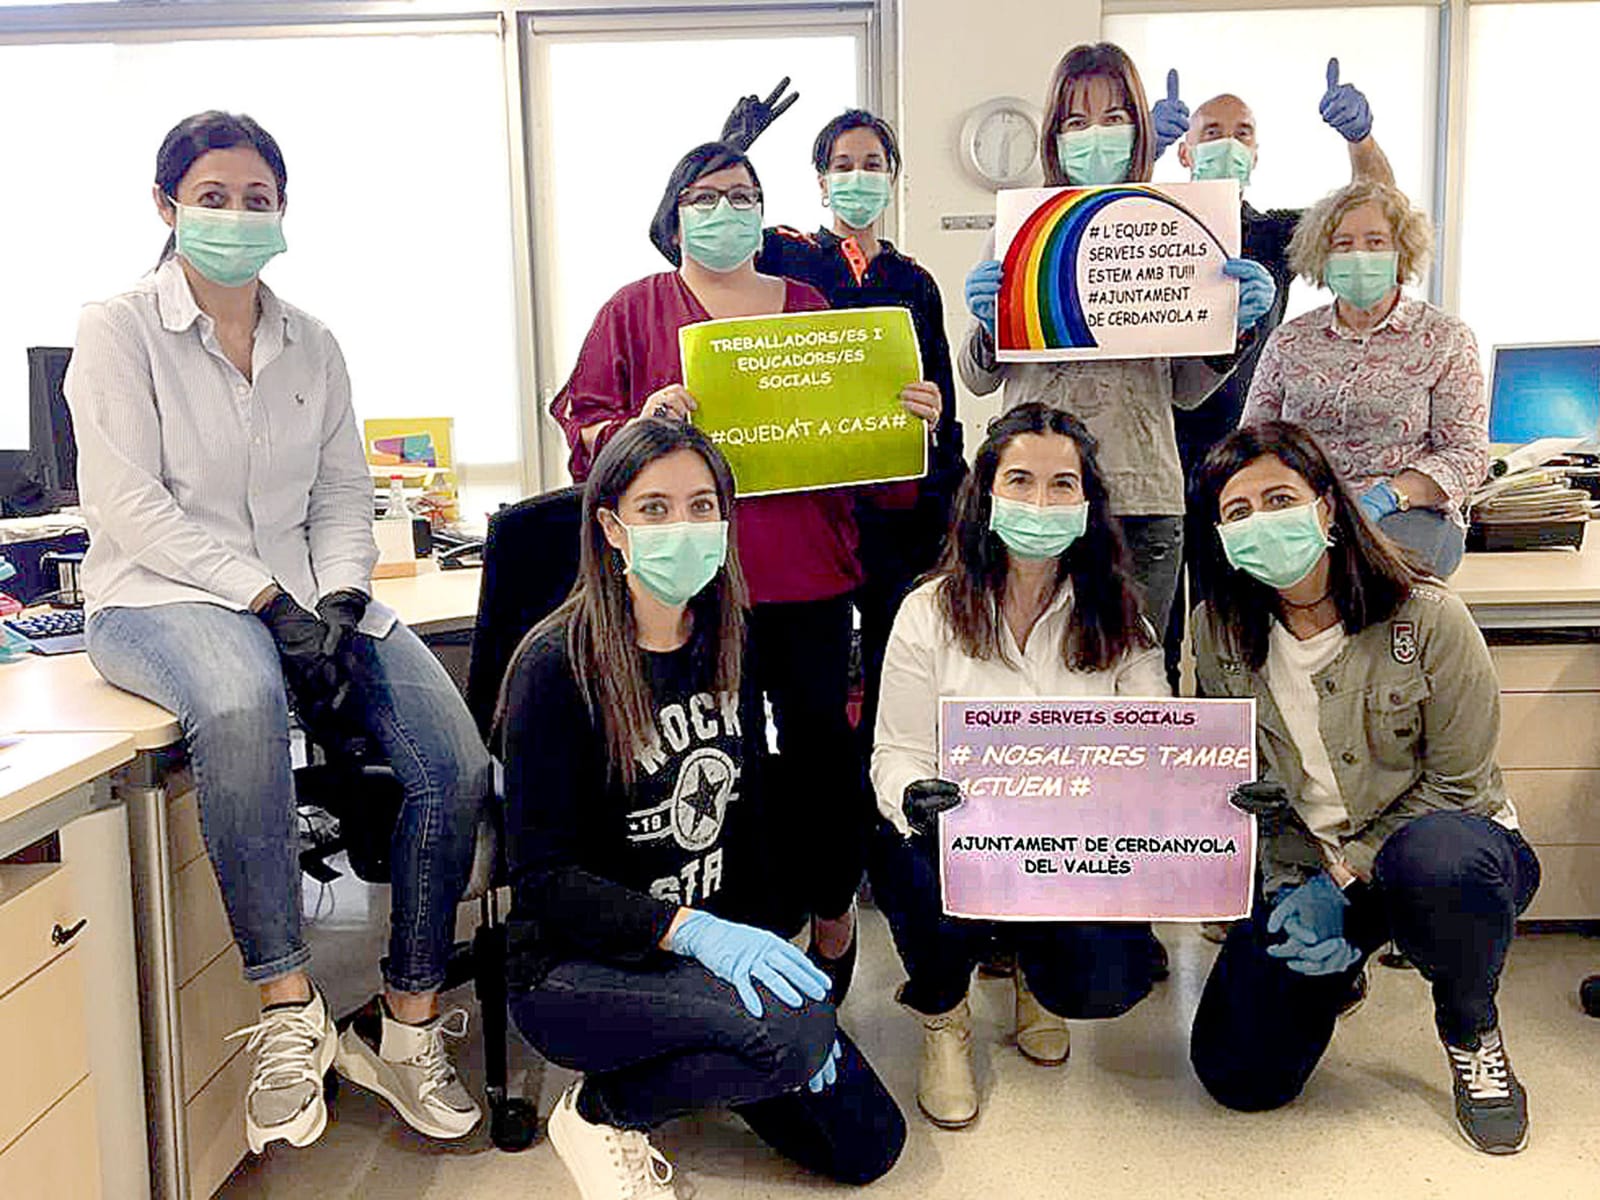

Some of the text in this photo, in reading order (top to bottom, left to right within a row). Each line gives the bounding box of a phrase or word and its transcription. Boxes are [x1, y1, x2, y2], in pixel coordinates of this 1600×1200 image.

[1089, 221, 1178, 240] # L'EQUIP DE
[1089, 243, 1207, 262] SERVEIS SOCIALS
[1088, 265, 1195, 284] ESTEM AMB TU!!!
[1088, 287, 1191, 305] #AJUNTAMENT
[1088, 309, 1208, 327] DE CERDANYOLA #
[710, 327, 883, 353] TREBALLADORS/ES I
[737, 349, 865, 371] EDUCADORS/ES
[758, 371, 832, 389] SOCIALS
[819, 420, 833, 437] A
[838, 414, 907, 435] CASA#
[965, 711, 1195, 727] EQUIP SERVEIS SOCIALS
[950, 744, 1250, 769] # NOSALTRES TAMBE
[1069, 775, 1092, 797] #
[951, 836, 1237, 855] AJUNTAMENT DE CERDANYOLA
[1025, 853, 1132, 876] DEL VALLÈS
